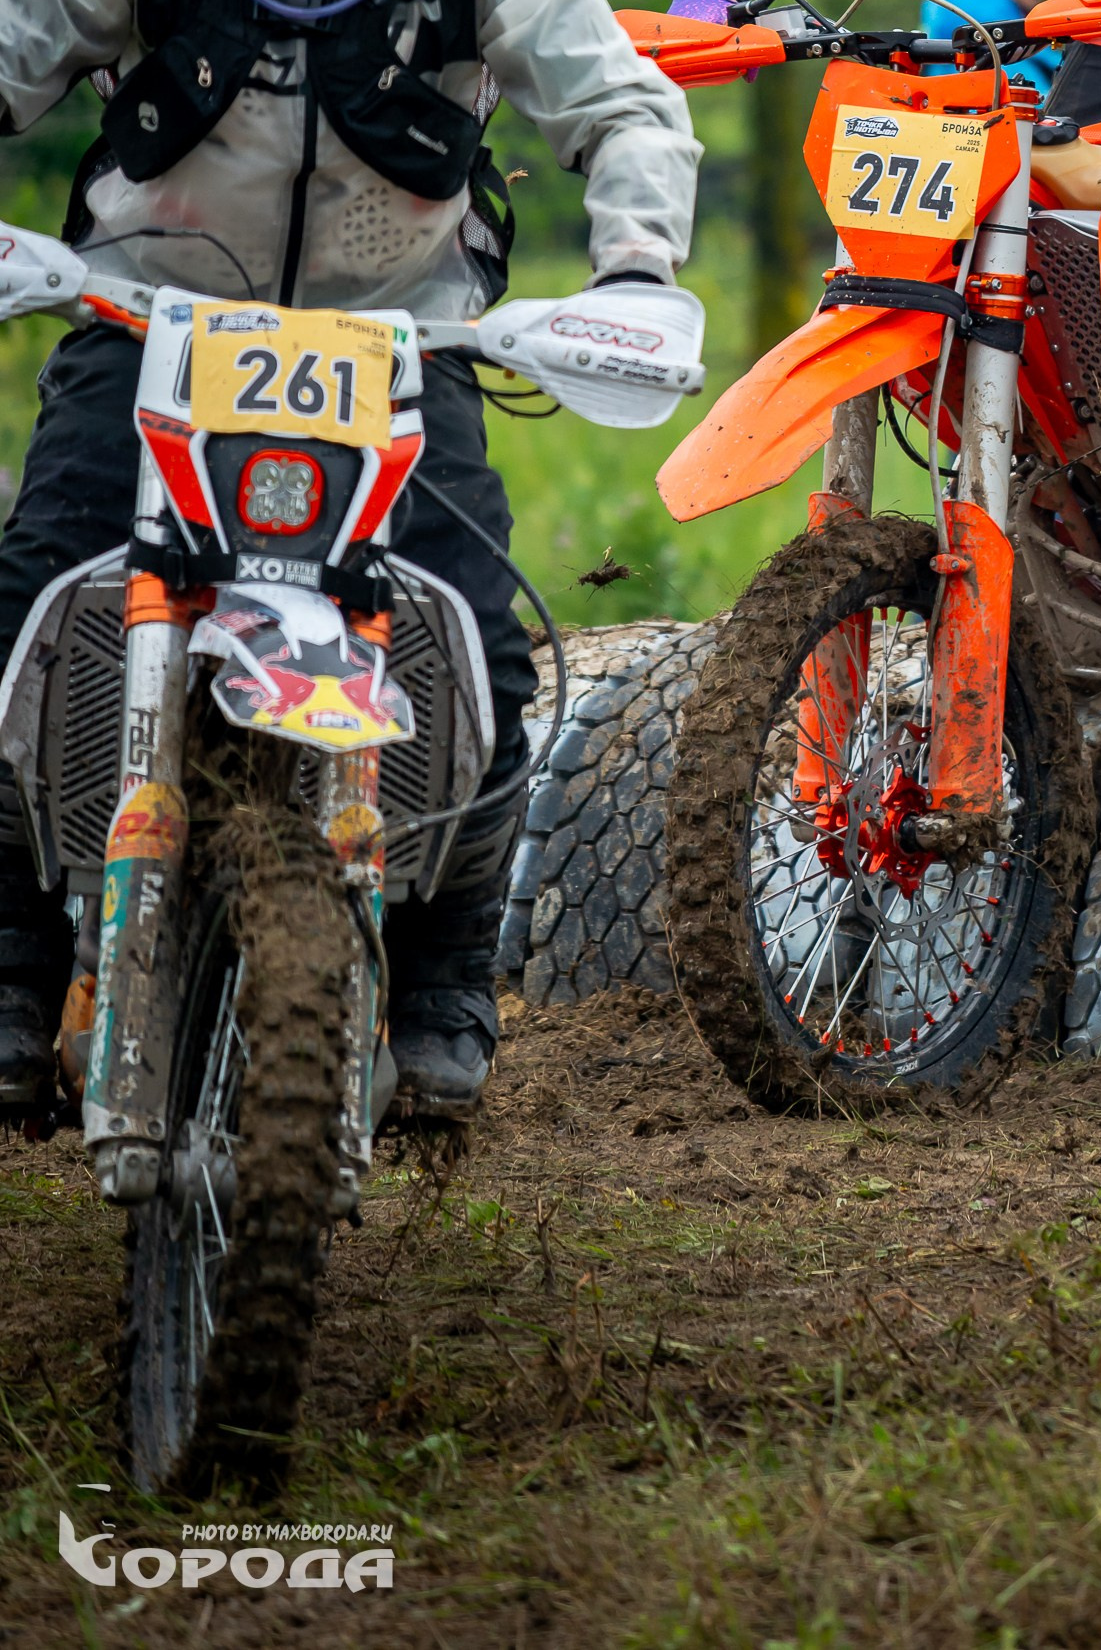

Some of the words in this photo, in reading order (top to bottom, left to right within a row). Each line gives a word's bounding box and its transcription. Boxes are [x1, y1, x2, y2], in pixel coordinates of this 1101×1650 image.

[966, 139, 981, 147] 2025
[848, 152, 955, 221] 274
[236, 349, 354, 424] 261
[238, 556, 285, 582] XO
